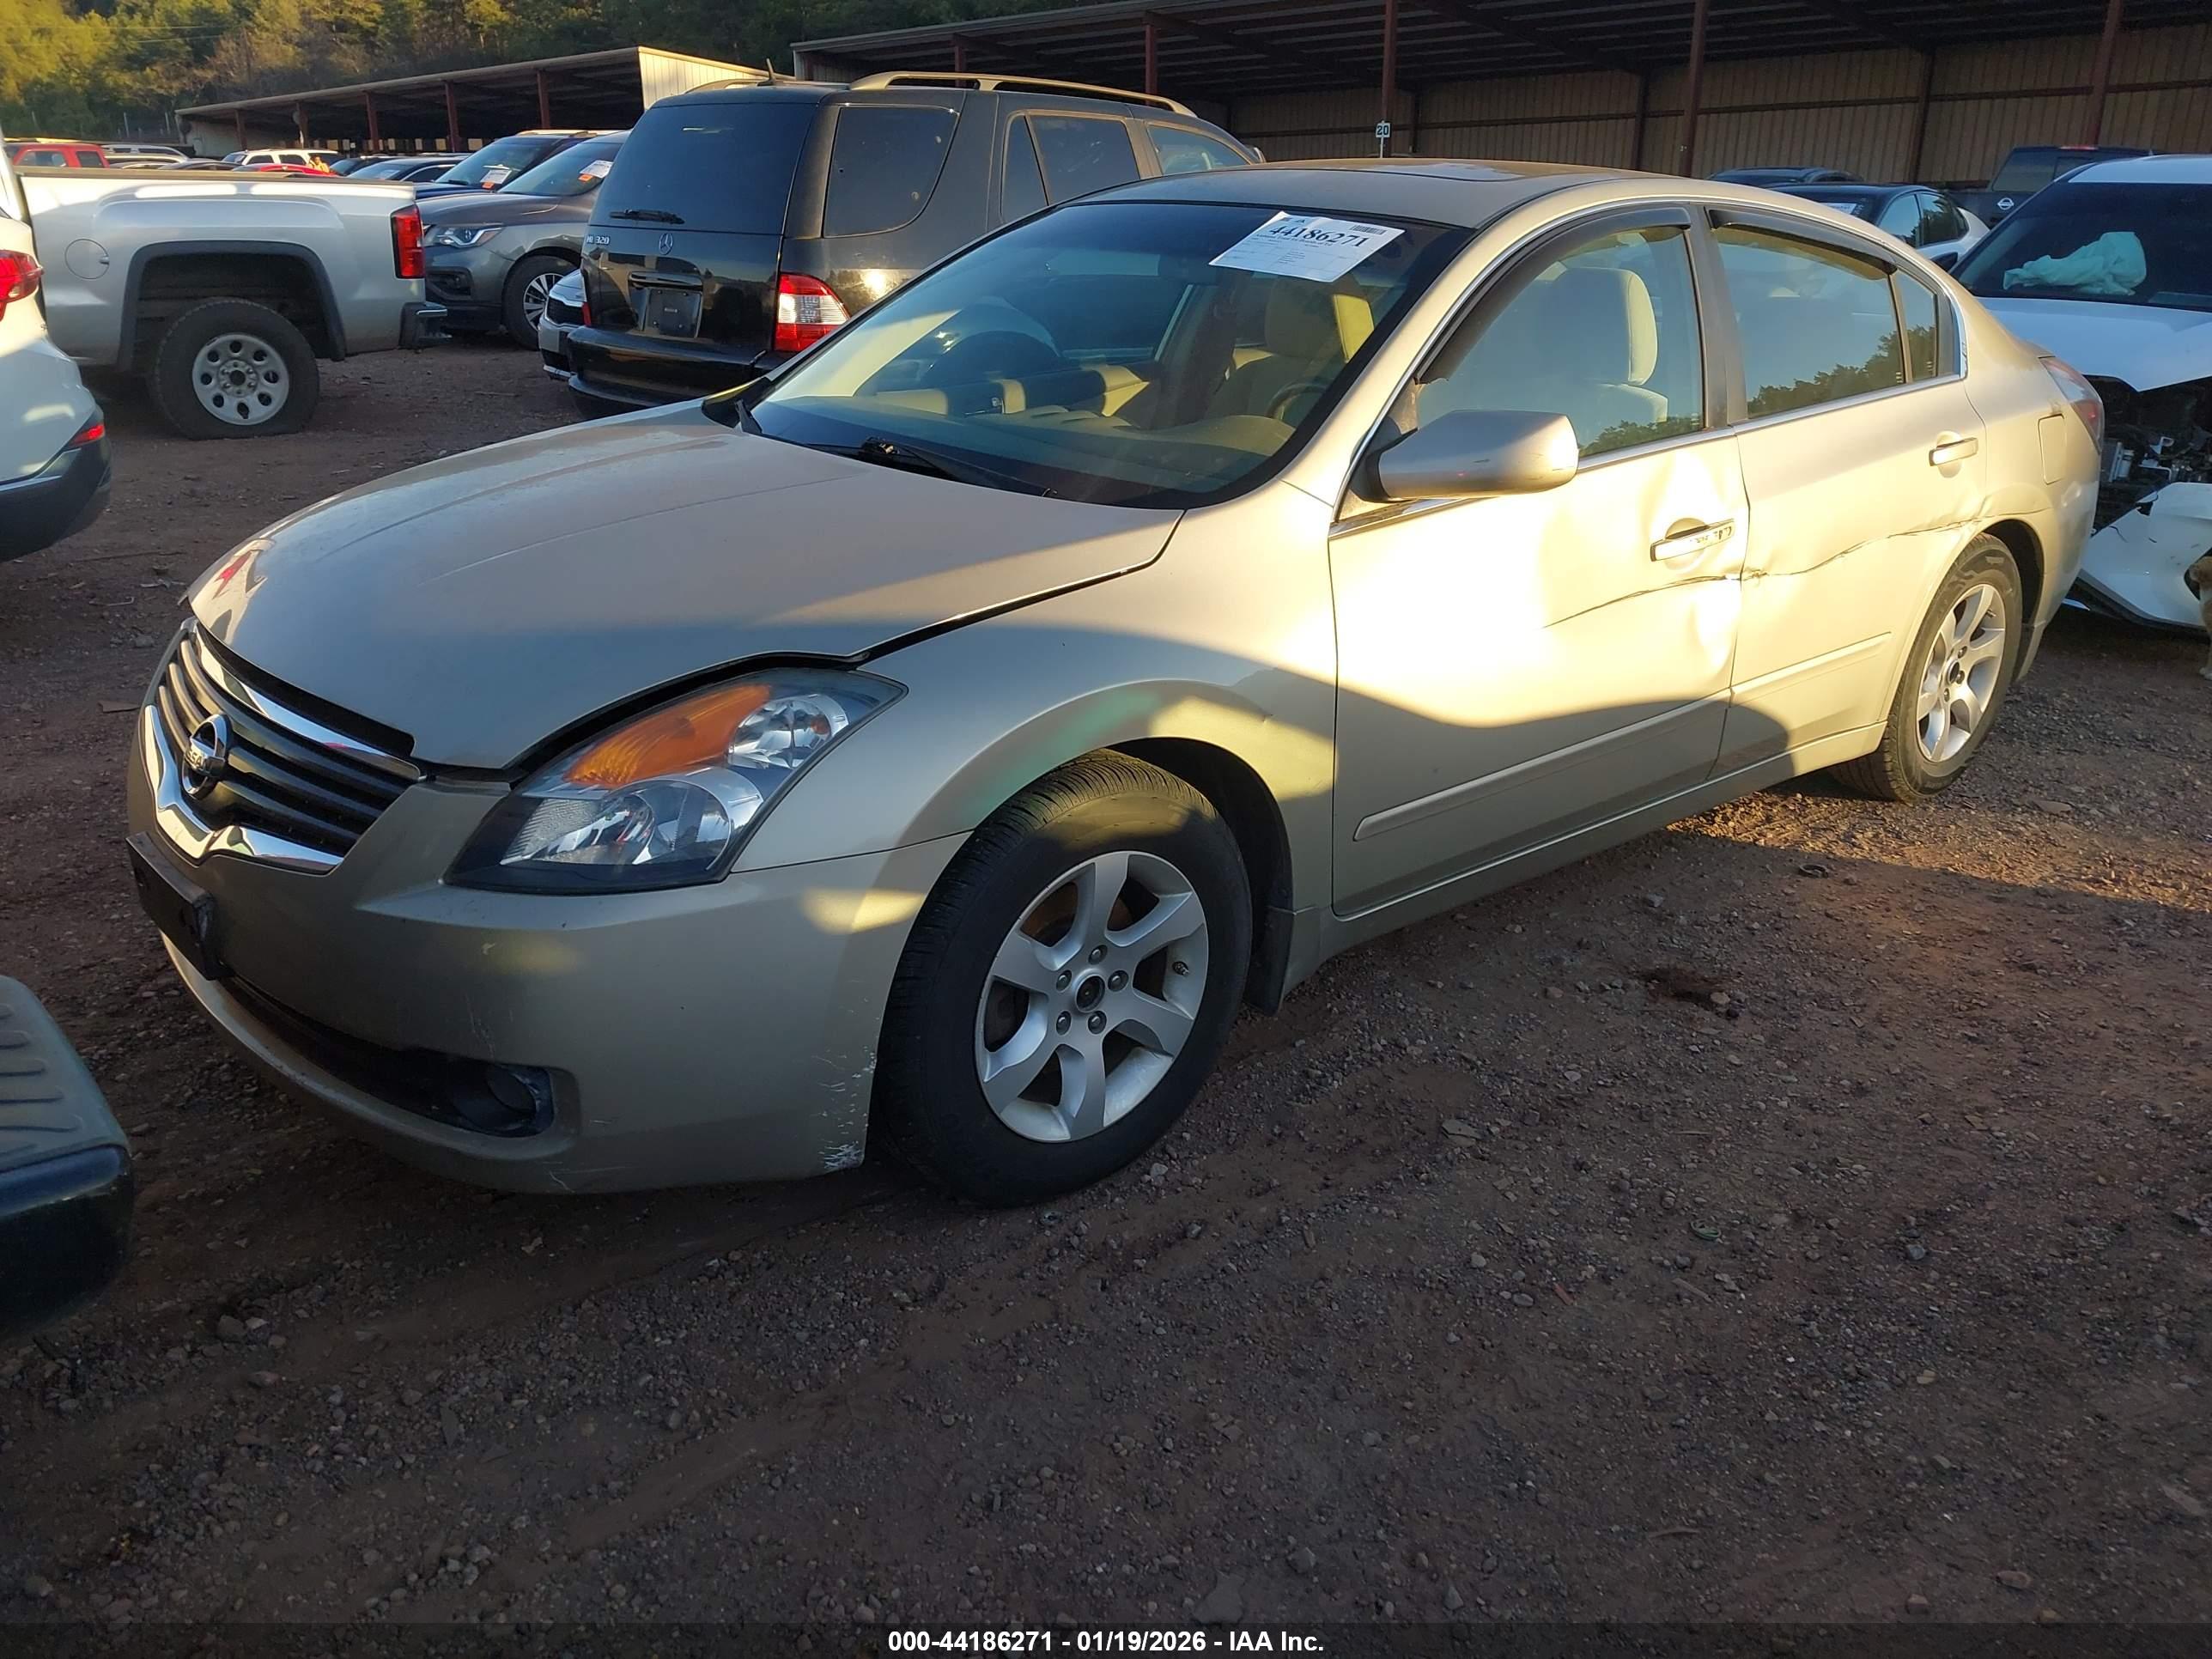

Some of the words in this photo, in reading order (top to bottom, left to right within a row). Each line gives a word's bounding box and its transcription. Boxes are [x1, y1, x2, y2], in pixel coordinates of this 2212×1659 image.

[1376, 125, 1389, 136] 20
[595, 235, 611, 246] 320
[1268, 224, 1370, 247] 44186271
